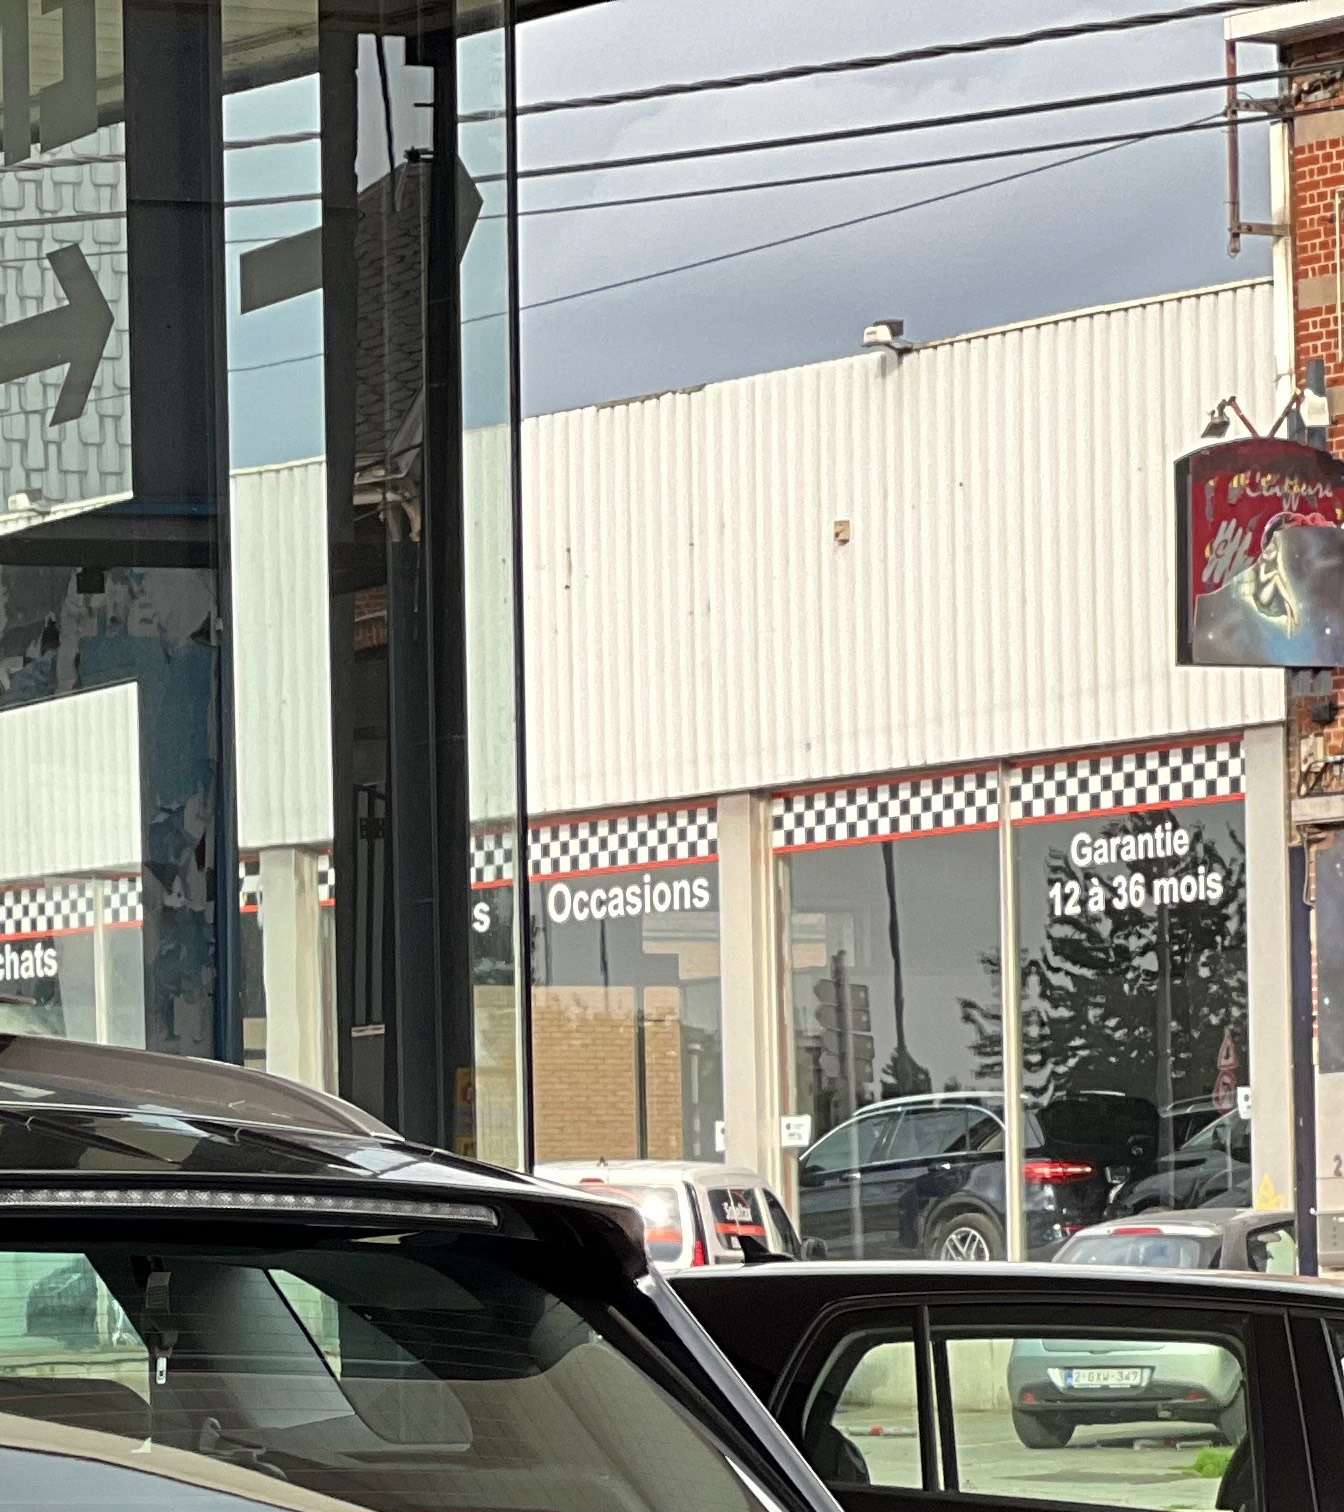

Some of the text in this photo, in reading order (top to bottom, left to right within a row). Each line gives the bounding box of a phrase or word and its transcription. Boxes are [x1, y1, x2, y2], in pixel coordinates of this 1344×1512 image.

[1070, 821, 1190, 867] Garantie
[547, 873, 710, 924] Occasions
[1048, 865, 1223, 916] 12 à 36 mois
